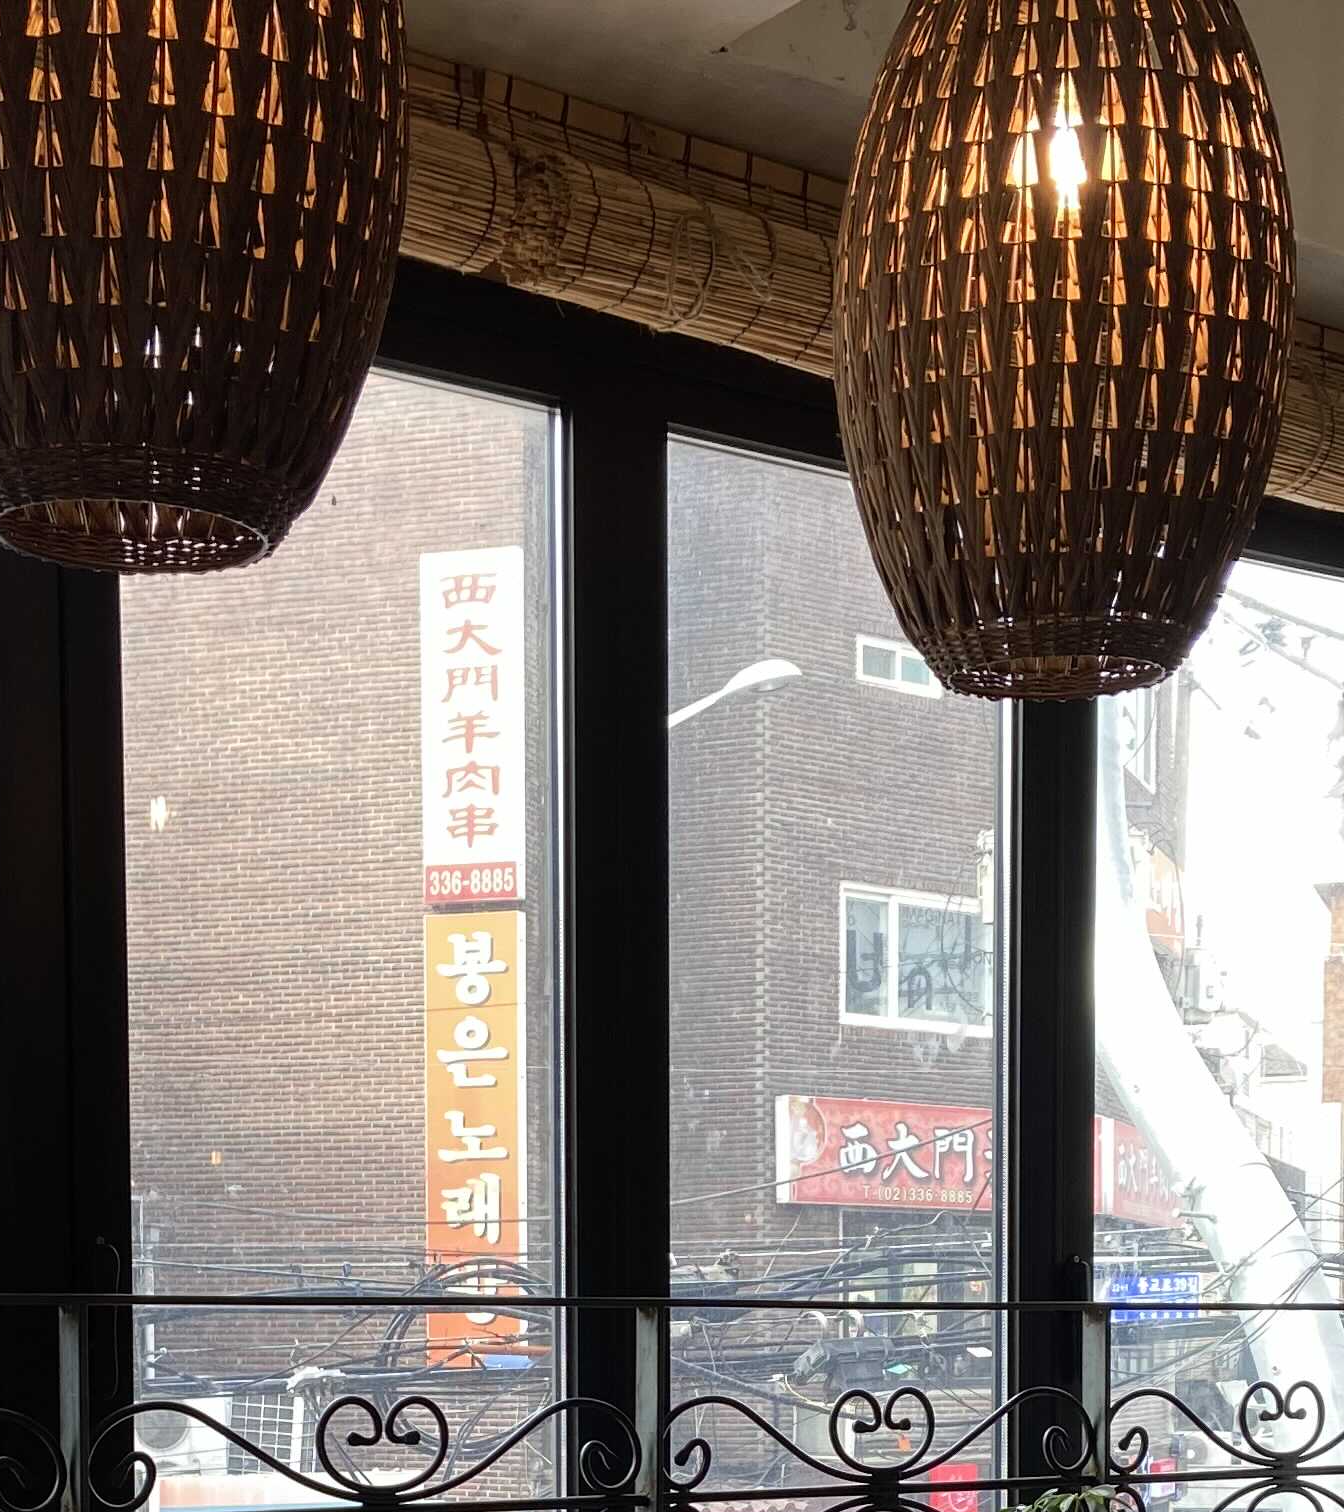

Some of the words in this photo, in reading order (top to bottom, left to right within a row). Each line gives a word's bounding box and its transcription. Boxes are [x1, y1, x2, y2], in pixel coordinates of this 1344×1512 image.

[440, 573, 503, 849] 西大門羊肉串
[429, 866, 514, 897] 336-8885
[839, 1121, 992, 1183] 西大門
